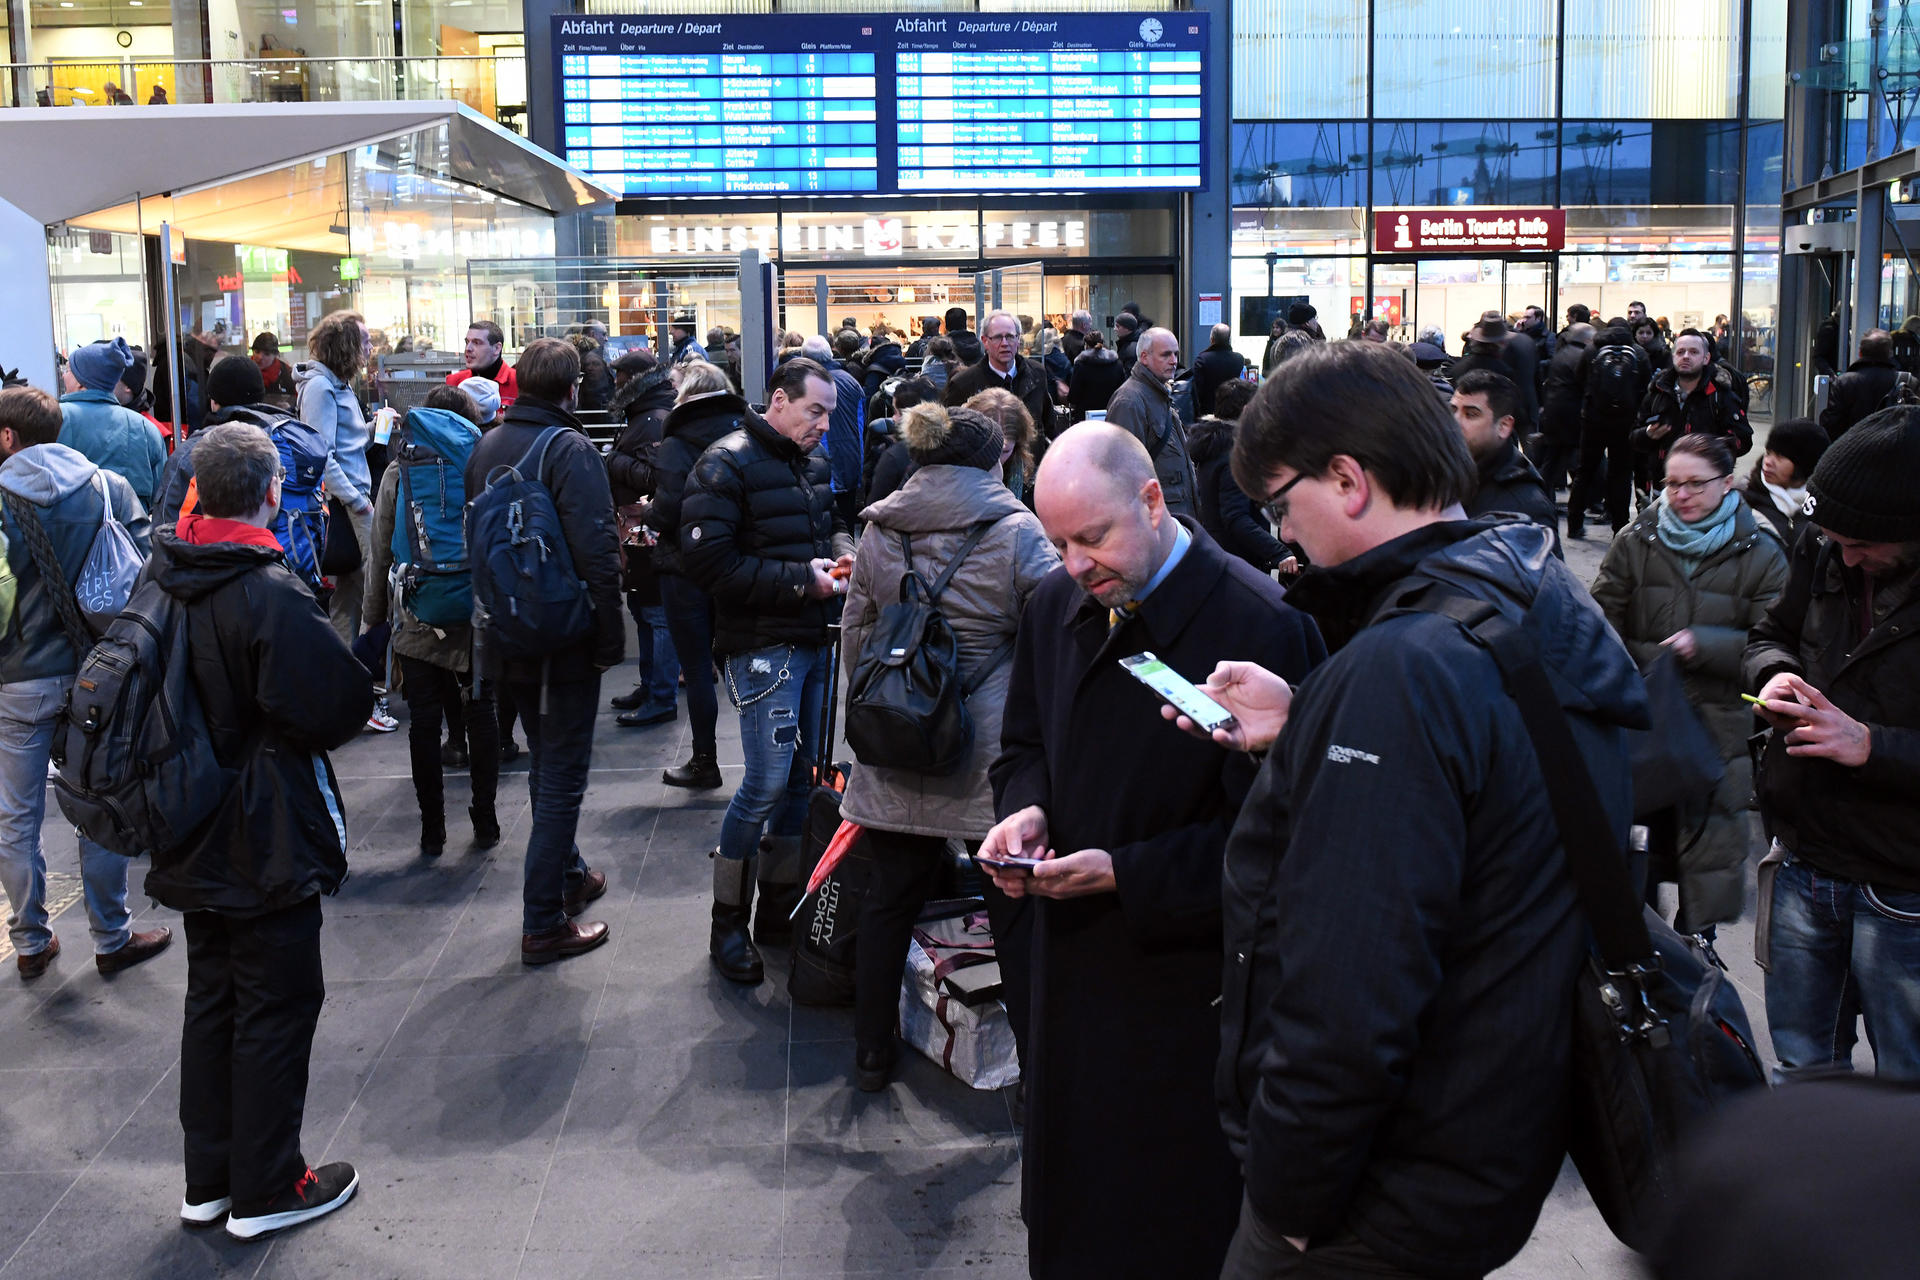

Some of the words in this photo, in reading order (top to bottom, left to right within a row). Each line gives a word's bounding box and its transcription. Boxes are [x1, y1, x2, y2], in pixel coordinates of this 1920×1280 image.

[561, 21, 614, 34] Abfahrt
[621, 23, 674, 36] Departure
[895, 18, 947, 33] Abfahrt
[958, 21, 1010, 34] Departure
[1022, 21, 1058, 34] Départ
[620, 43, 635, 51] Über
[801, 42, 816, 50] Gleis
[897, 41, 909, 49] Zeit
[952, 40, 967, 49] Über
[1421, 218, 1463, 235] Berlin
[1466, 217, 1516, 235] Tourist
[917, 221, 1085, 249] KAFFEE
[823, 881, 841, 945] UTILITY
